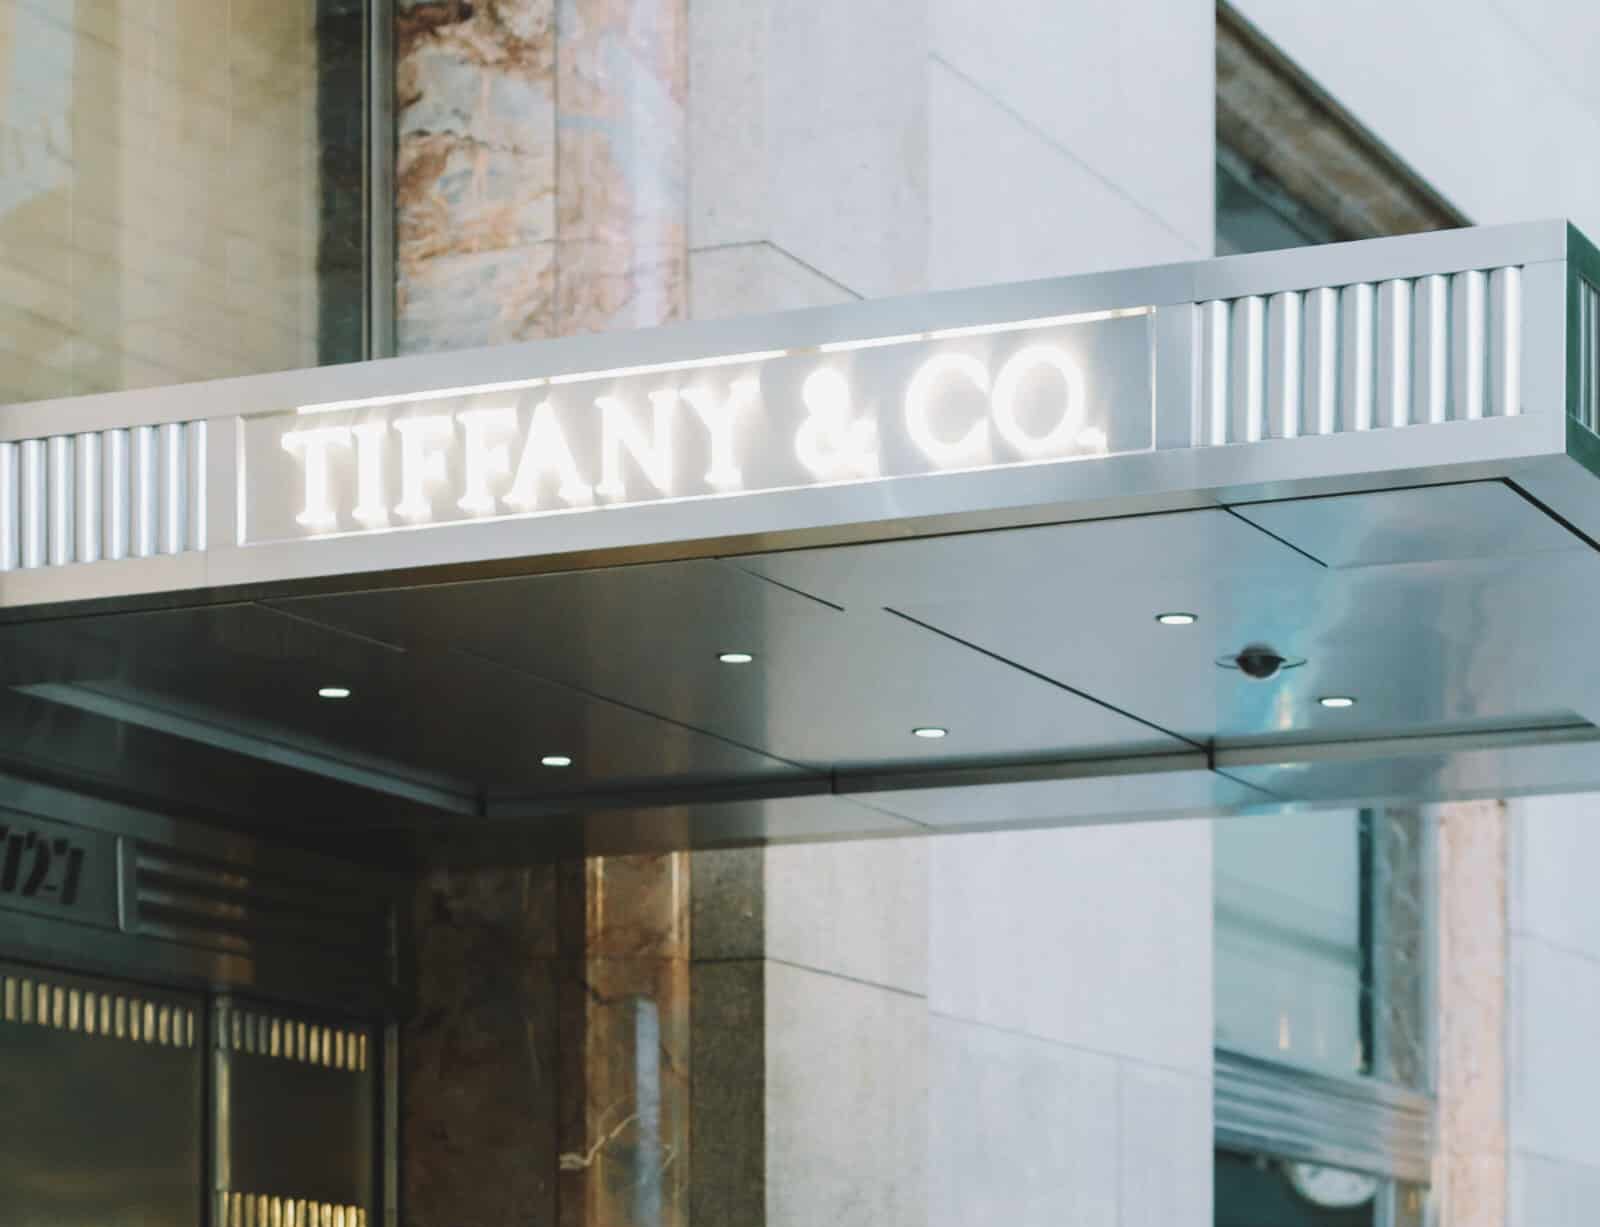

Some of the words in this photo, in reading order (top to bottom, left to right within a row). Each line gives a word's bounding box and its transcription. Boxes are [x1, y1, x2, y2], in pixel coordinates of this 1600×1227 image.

[281, 380, 762, 528] TIFFANY
[793, 366, 877, 480] &
[903, 344, 1108, 463] CO.
